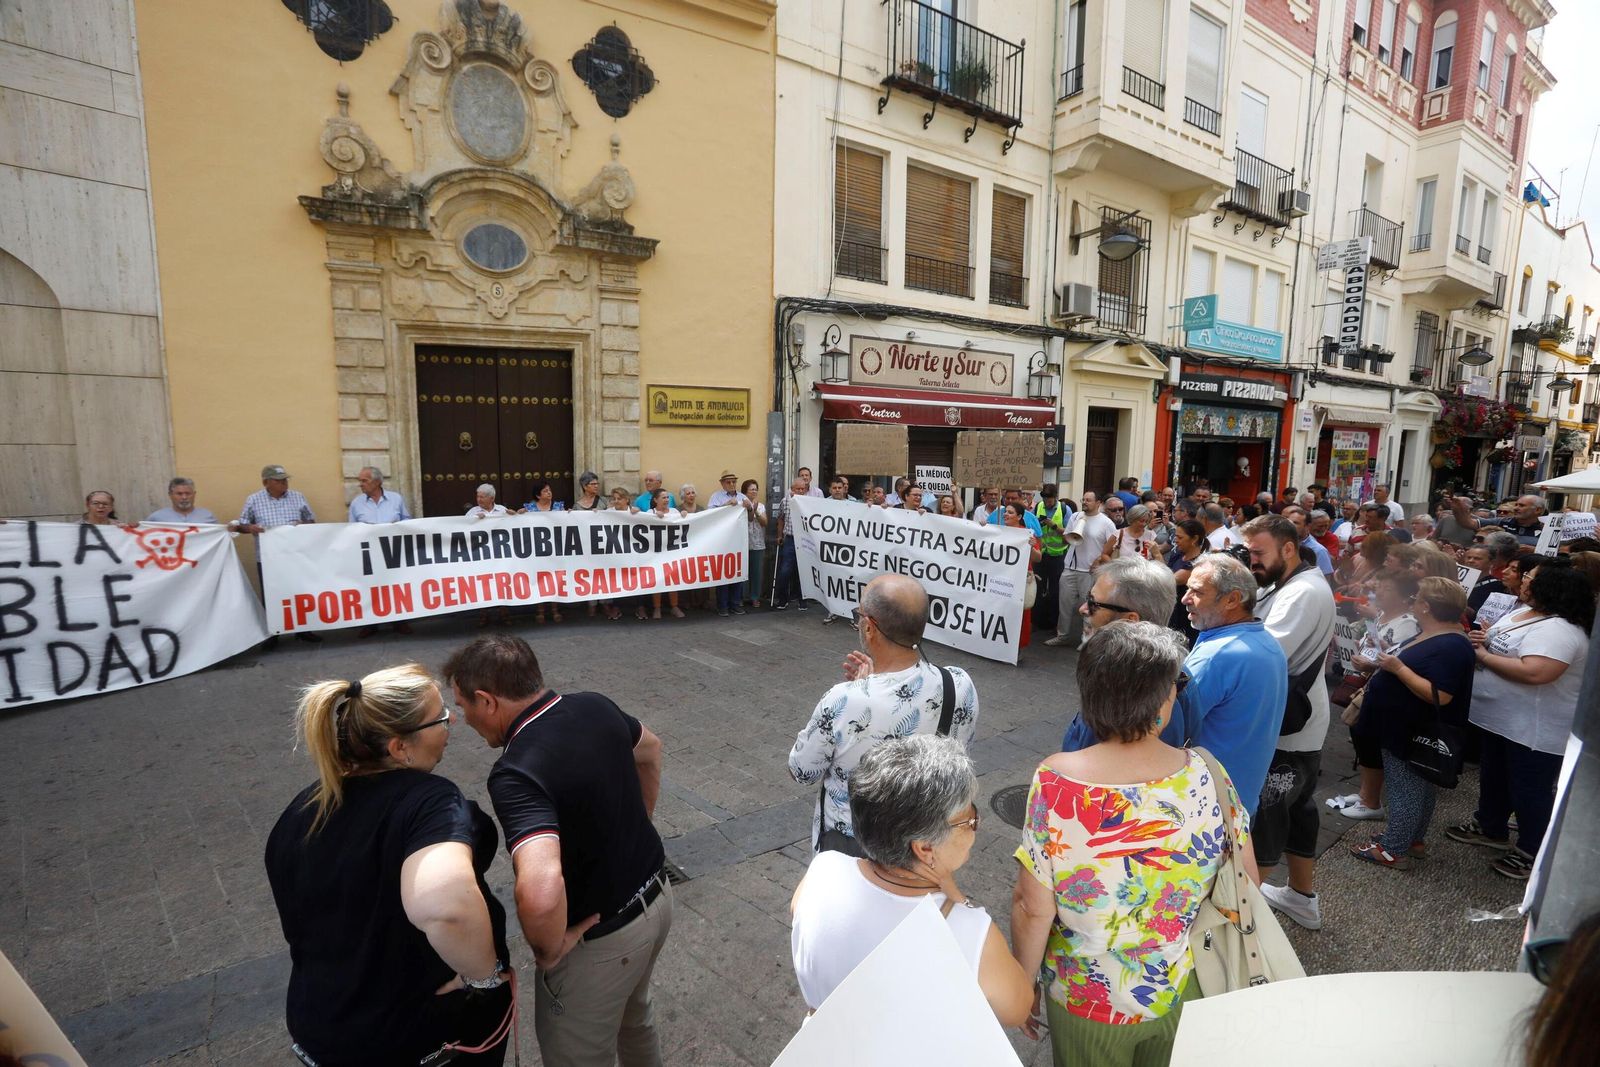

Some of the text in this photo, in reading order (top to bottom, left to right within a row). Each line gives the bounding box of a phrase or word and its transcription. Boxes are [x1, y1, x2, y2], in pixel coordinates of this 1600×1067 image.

[1341, 266, 1364, 342] ABOGADOS
[888, 343, 985, 379] Norte y Sur
[919, 377, 960, 389] Taberna Selecta
[1181, 380, 1218, 393] PIZZERIA
[669, 400, 693, 409] JUNTA
[695, 400, 705, 410] DE
[860, 403, 902, 419] Pintxos
[669, 411, 745, 421] Delegación del Gobierno
[1004, 411, 1033, 426] Tapas
[960, 435, 974, 447] EL
[978, 434, 1010, 447] PSOE
[976, 446, 1037, 458] EL CENTRO
[962, 459, 973, 468] EL
[990, 457, 1001, 465] DE
[1003, 456, 1041, 466] MORENO
[916, 468, 950, 479] EL MÉDICO
[918, 482, 951, 491] SE QUEDA
[980, 475, 1028, 487] CENTRO
[378, 525, 584, 570] VILLARRUBIA
[590, 523, 690, 555] EXISTE!
[856, 519, 947, 552] NUESTRA
[953, 535, 1020, 566] SALUD
[823, 545, 854, 565] NO
[857, 550, 879, 570] SE
[884, 554, 988, 593] NEGOCIA!!
[282, 551, 742, 631] ¡POR UN CENTRO DE SALUD NUEVO!
[950, 602, 976, 635] SE
[980, 610, 1009, 644] VA
